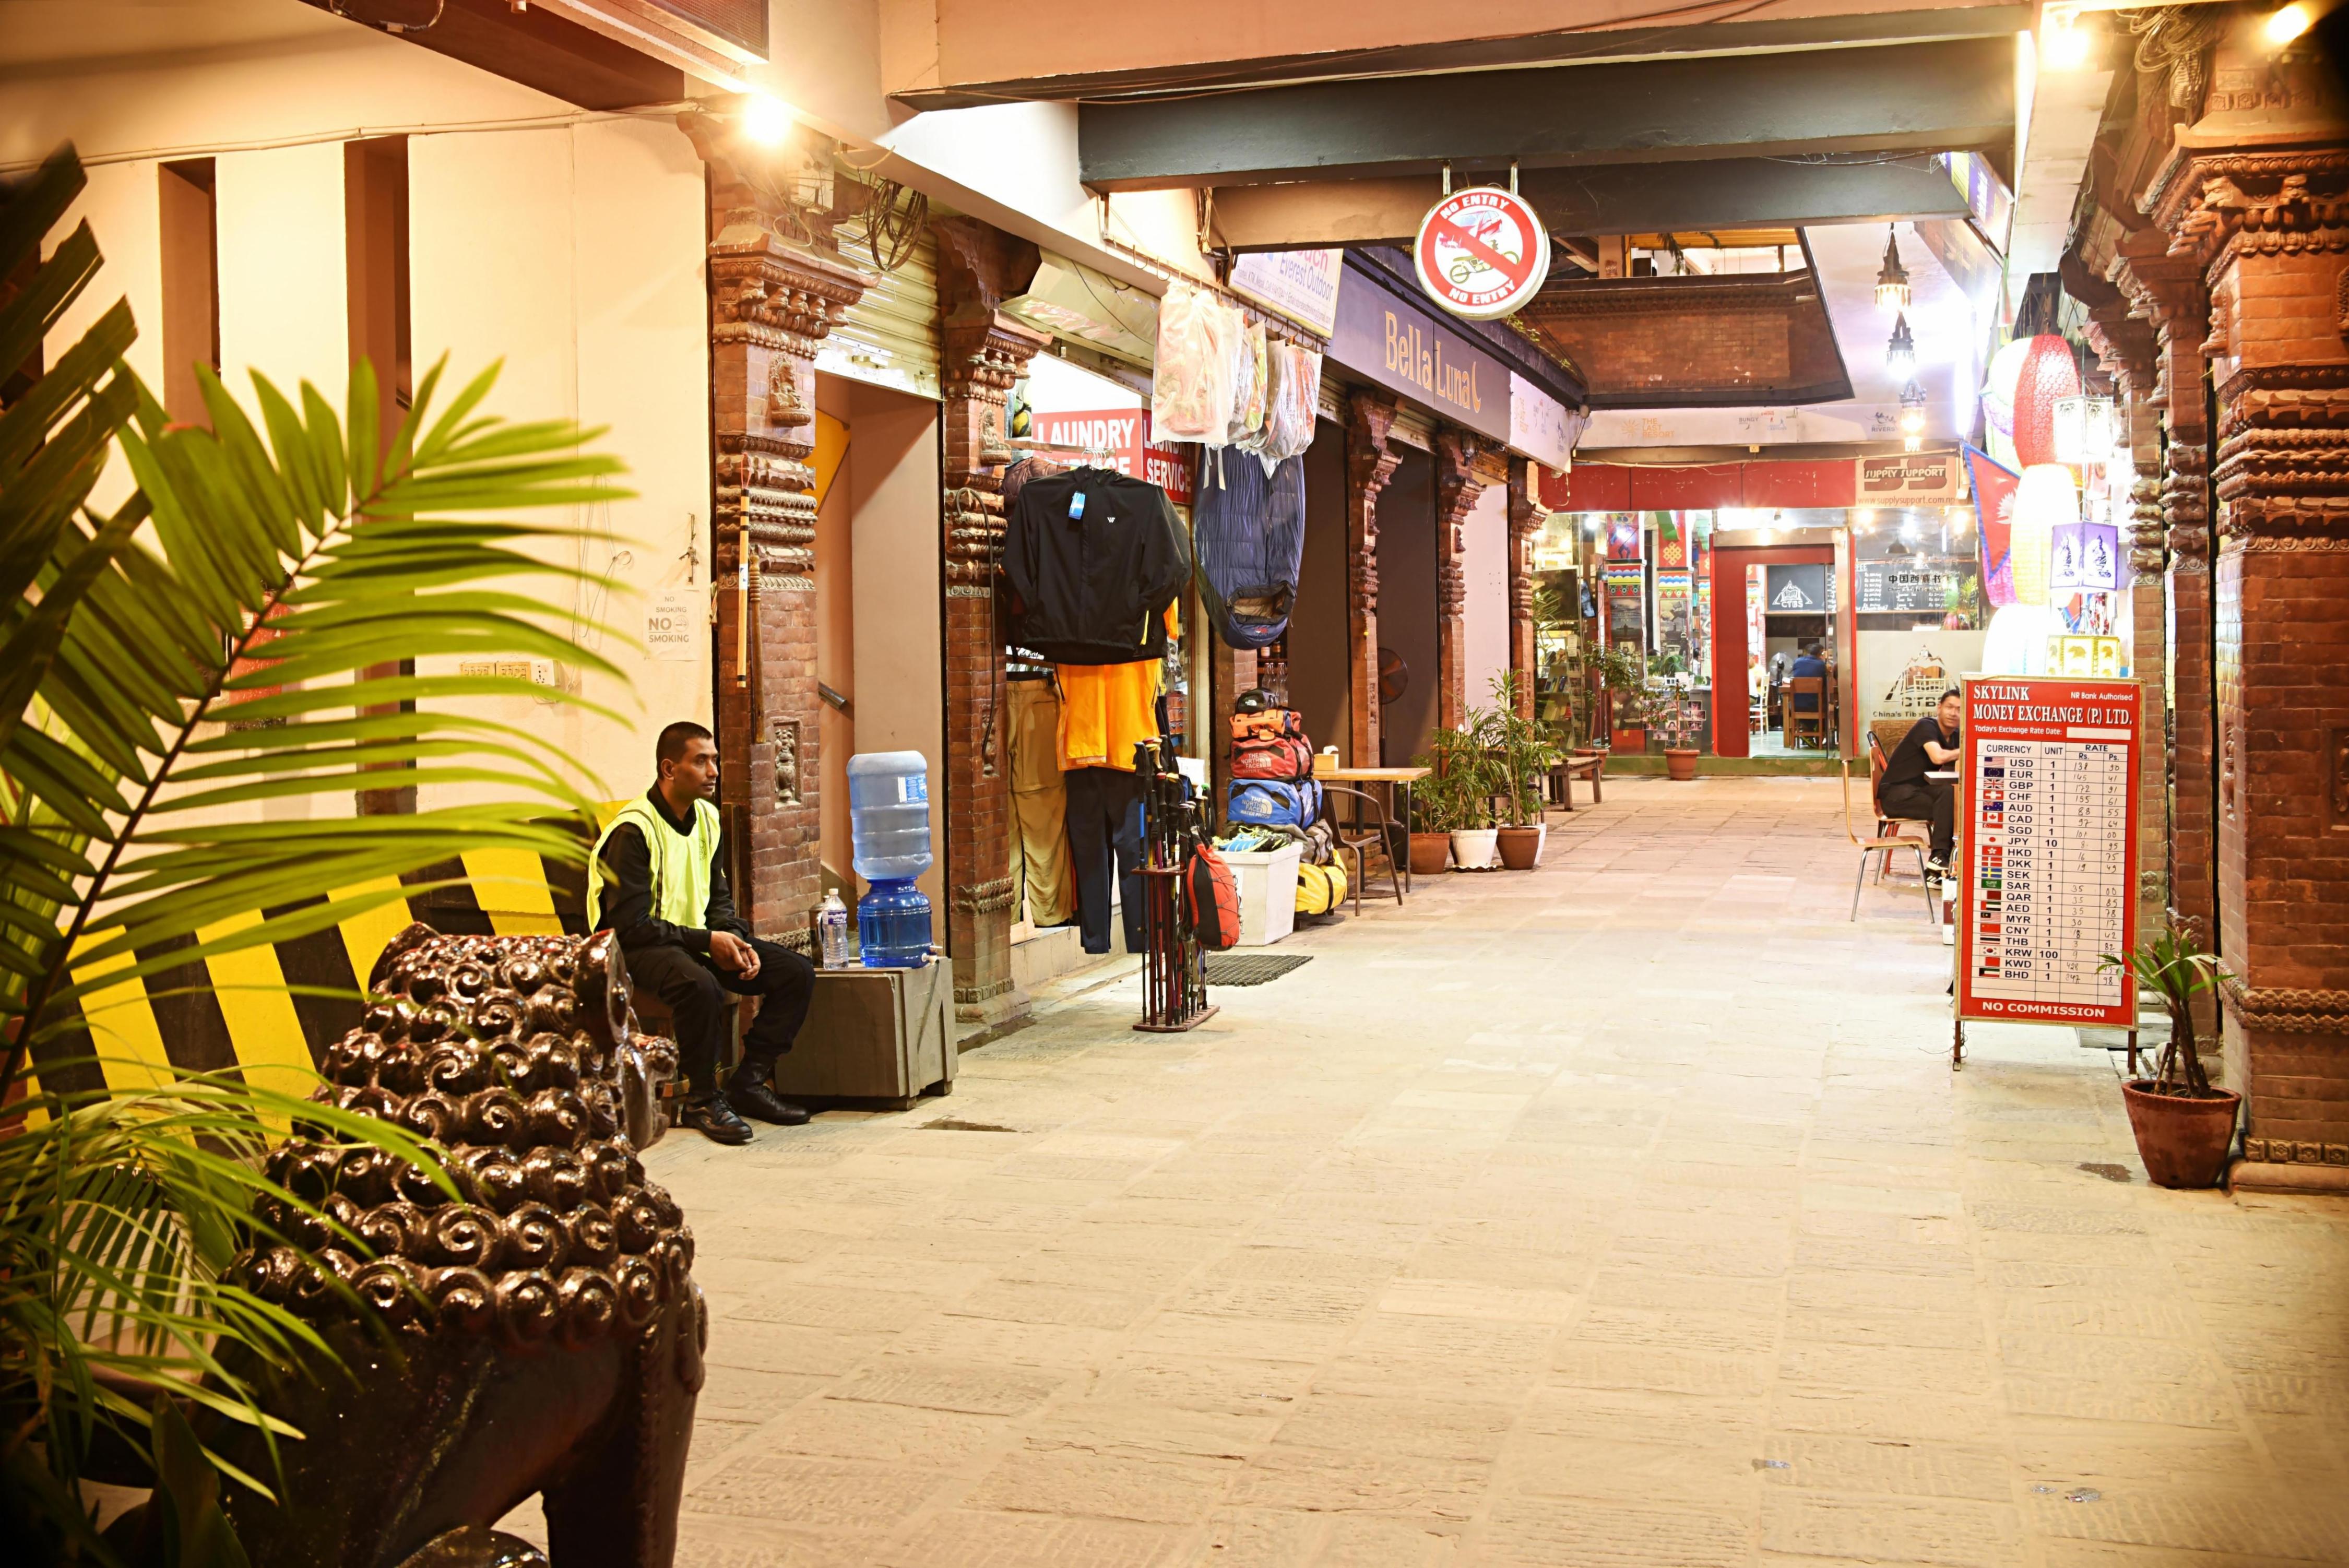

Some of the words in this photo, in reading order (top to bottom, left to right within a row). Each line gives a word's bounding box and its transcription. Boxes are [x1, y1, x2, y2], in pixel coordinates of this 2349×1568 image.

[1440, 201, 1460, 219] NO
[1462, 195, 1510, 210] ENTRY
[1279, 252, 1307, 287] Everest
[1307, 266, 1333, 301] Outdoor
[1449, 288, 1467, 303] NO
[1472, 280, 1515, 304] ENTRY
[1385, 311, 1432, 391] Bella
[1436, 340, 1470, 410] Luna
[1037, 418, 1135, 448] LAUNDRY
[1147, 457, 1191, 493] SERVICE
[1866, 470, 1897, 478] SUPPLY
[1901, 468, 1944, 477] SUPPORT
[648, 617, 672, 631] NO
[649, 634, 689, 643] SMOKING
[1974, 685, 2030, 700] SKYLINK
[1973, 704, 2015, 720] MONEY
[2018, 705, 2083, 723] EXCHANGE
[2106, 708, 2132, 725] LTD.
[1998, 726, 2028, 734] Exchange
[1987, 744, 2032, 753] CURRENCY
[2045, 747, 2063, 755] UNIT
[2010, 759, 2033, 767] USD
[1242, 799, 1261, 808] NORTH
[2008, 860, 2031, 868] DKK
[2007, 871, 2030, 879] SEK
[2007, 893, 2031, 901] QAR
[2007, 904, 2030, 912] AED
[2006, 948, 2032, 957] KRW
[2005, 970, 2028, 979] BHD
[1982, 1002, 2003, 1011] NO
[2008, 1003, 2105, 1017] COMMISSION
